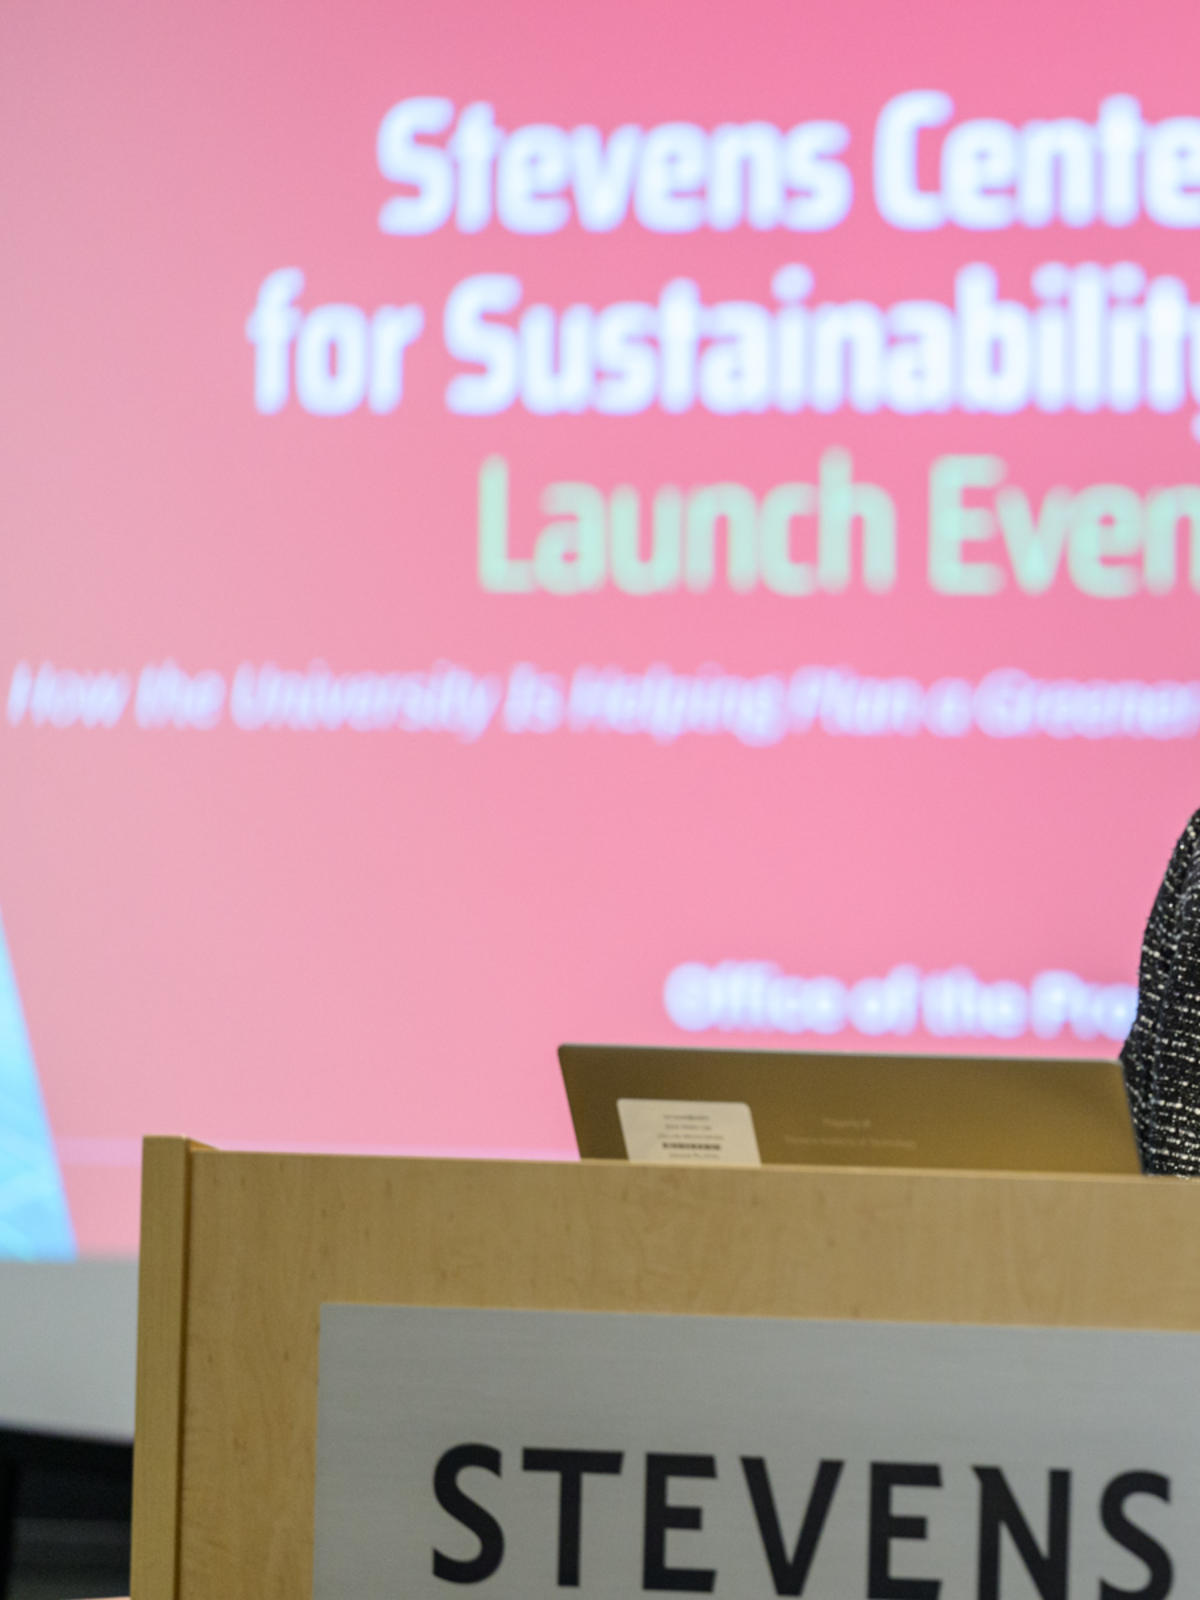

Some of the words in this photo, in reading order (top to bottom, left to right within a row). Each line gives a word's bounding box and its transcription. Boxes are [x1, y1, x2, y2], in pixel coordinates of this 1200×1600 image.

[376, 96, 854, 236] Stevens
[245, 266, 425, 416] for
[477, 444, 898, 598] Launch
[8, 658, 131, 729] How
[229, 657, 500, 744] University
[568, 661, 788, 747] Helping
[664, 959, 848, 1035] Office
[848, 963, 921, 1037] of
[921, 964, 1028, 1039] the
[1030, 969, 1139, 1042] Pro
[432, 1442, 1175, 1600] STEVENS
